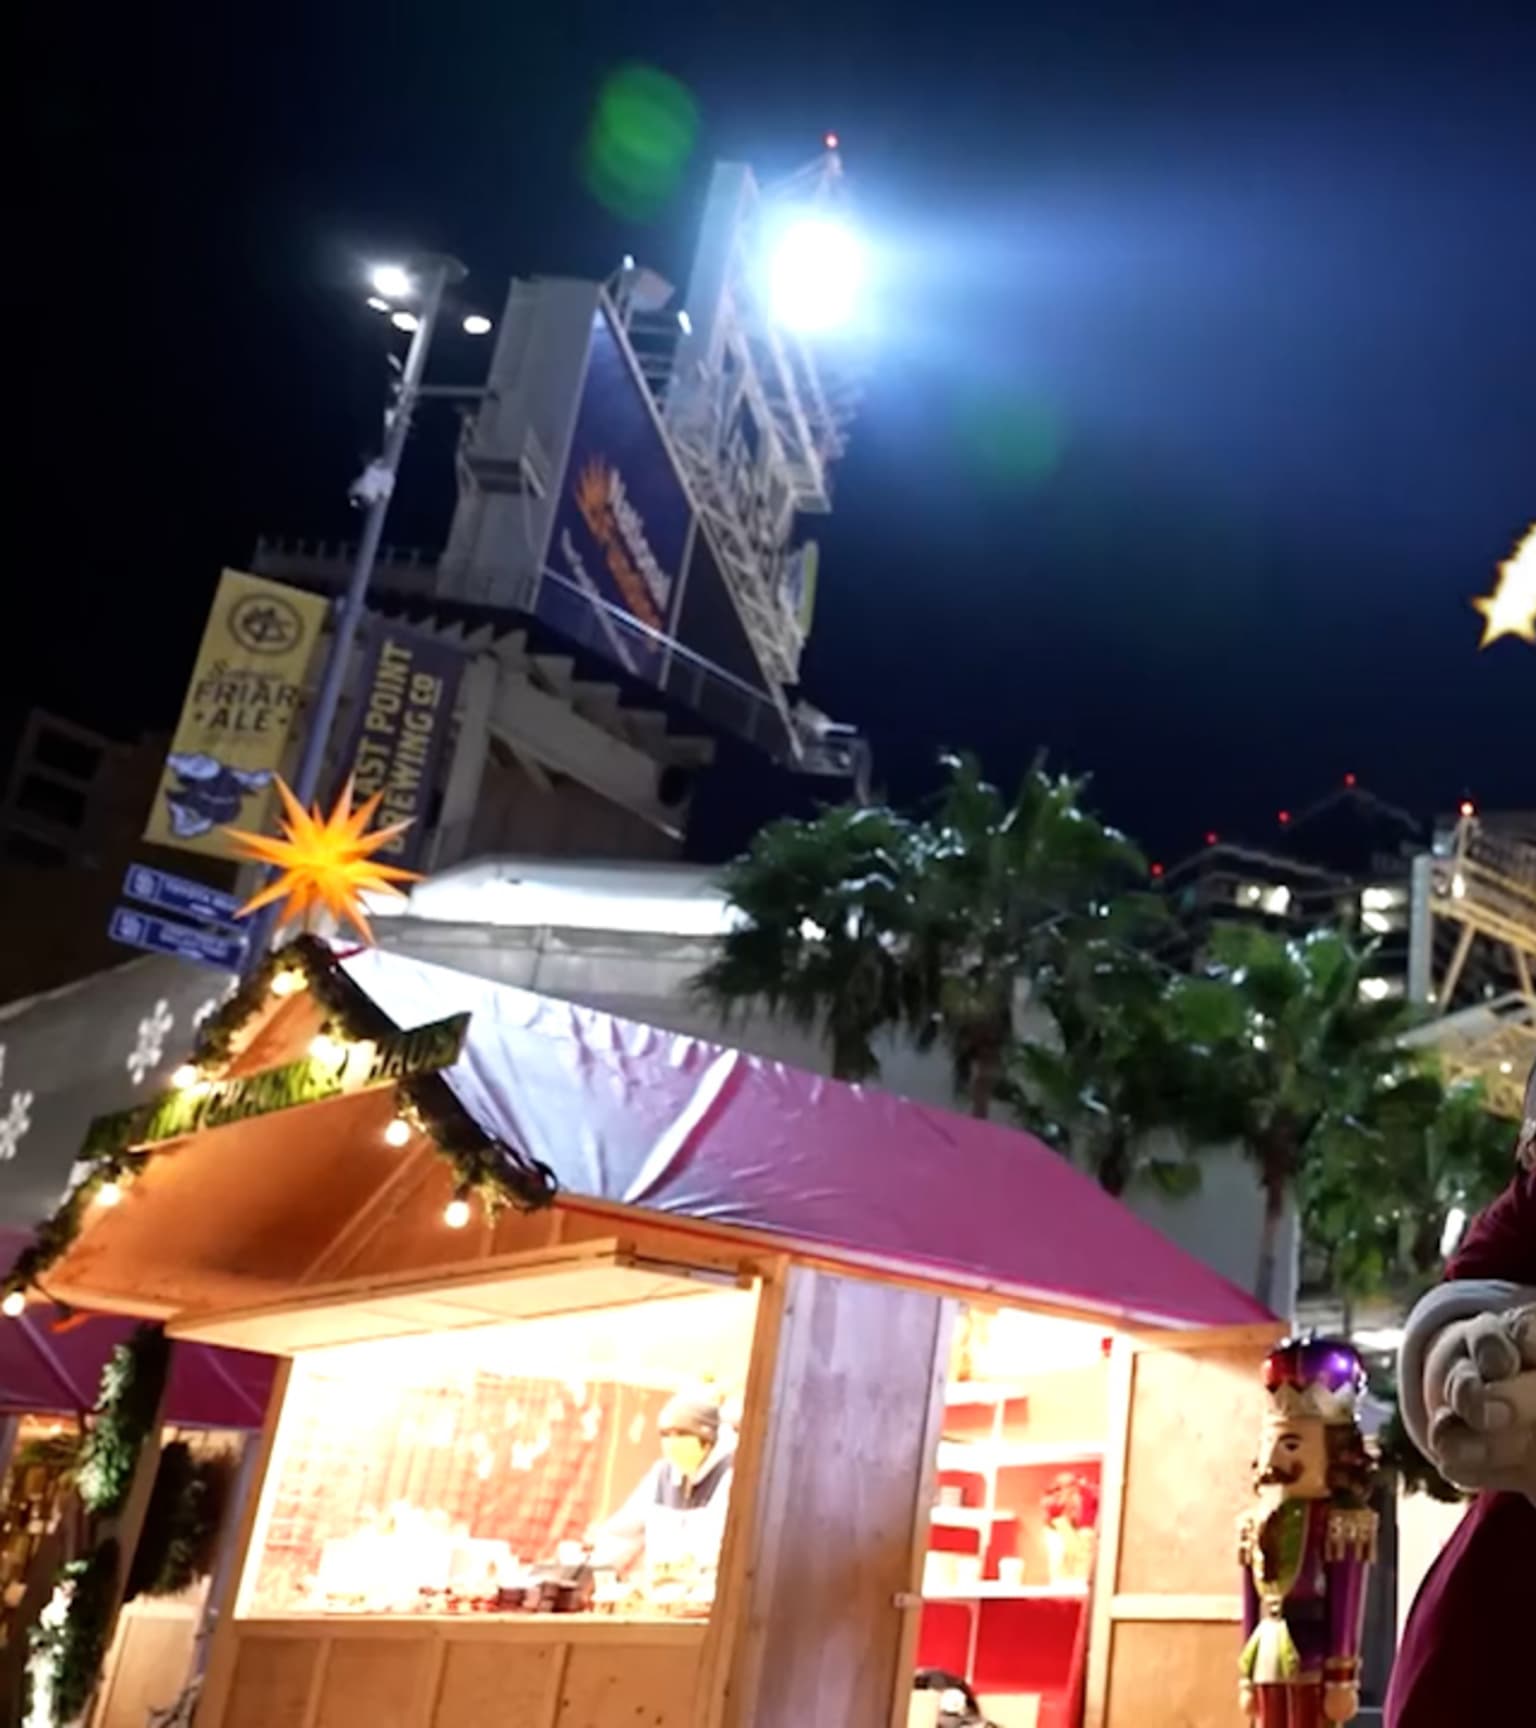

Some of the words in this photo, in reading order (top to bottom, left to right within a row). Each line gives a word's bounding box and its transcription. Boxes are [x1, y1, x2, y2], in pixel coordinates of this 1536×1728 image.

[194, 676, 299, 709] FRIAR
[365, 640, 412, 733] POINT
[210, 706, 271, 733] ALE
